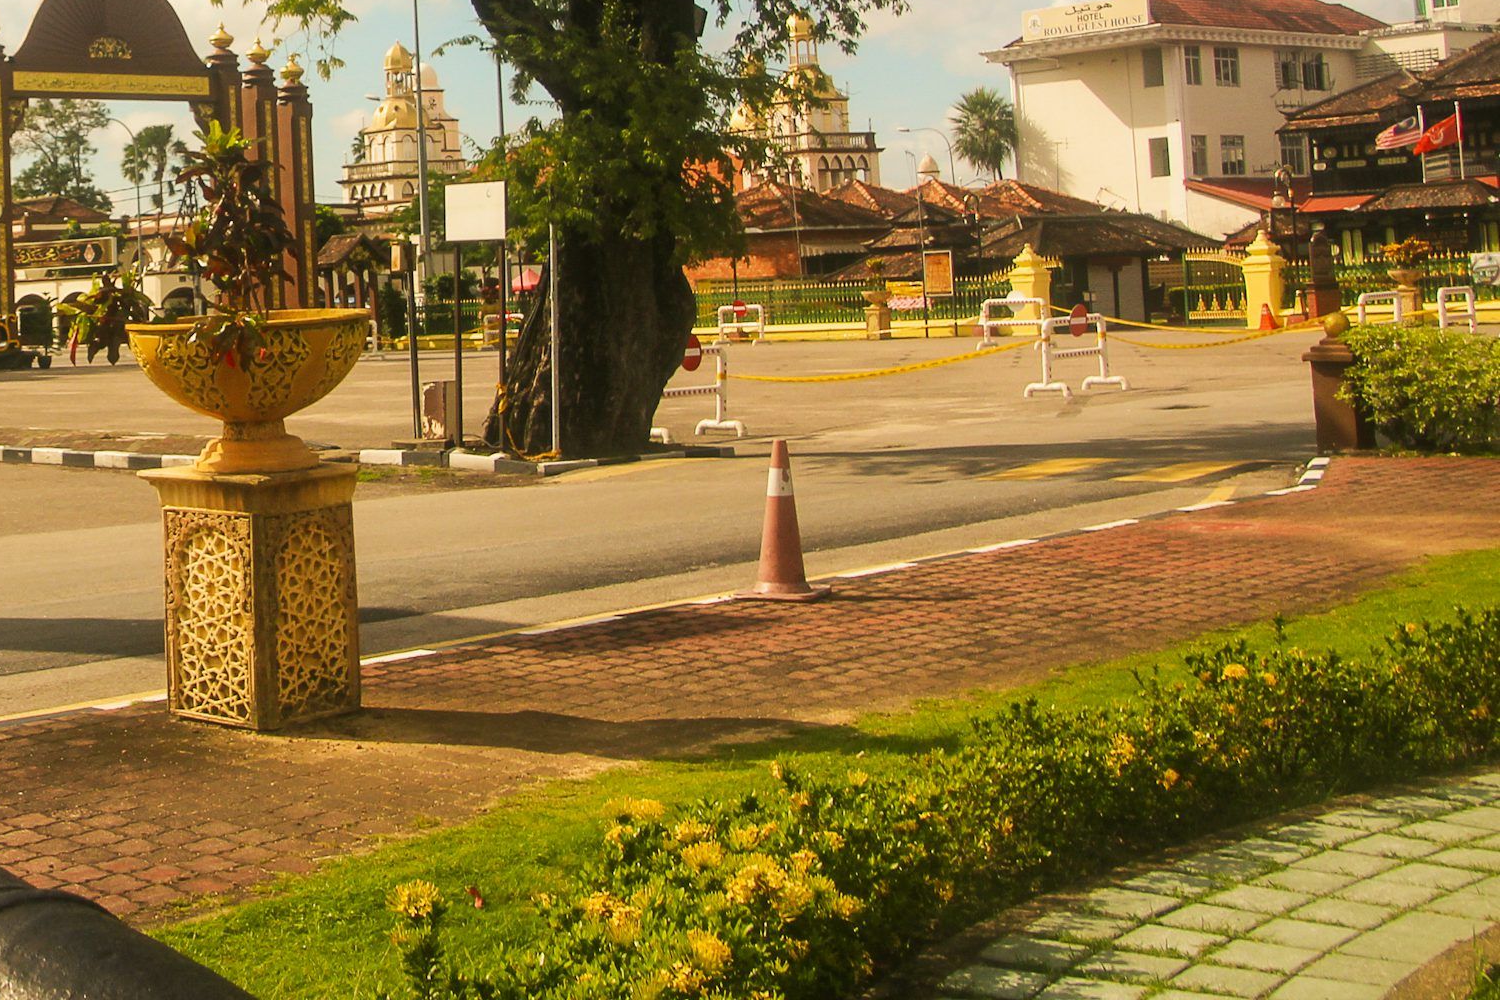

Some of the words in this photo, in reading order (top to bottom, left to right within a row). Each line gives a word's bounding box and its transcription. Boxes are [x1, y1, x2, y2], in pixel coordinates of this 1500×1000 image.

[1077, 12, 1104, 22] HOTEL
[1044, 26, 1073, 36] ROYAL
[1077, 20, 1108, 31] GUEST
[1111, 15, 1143, 27] HOUSE
